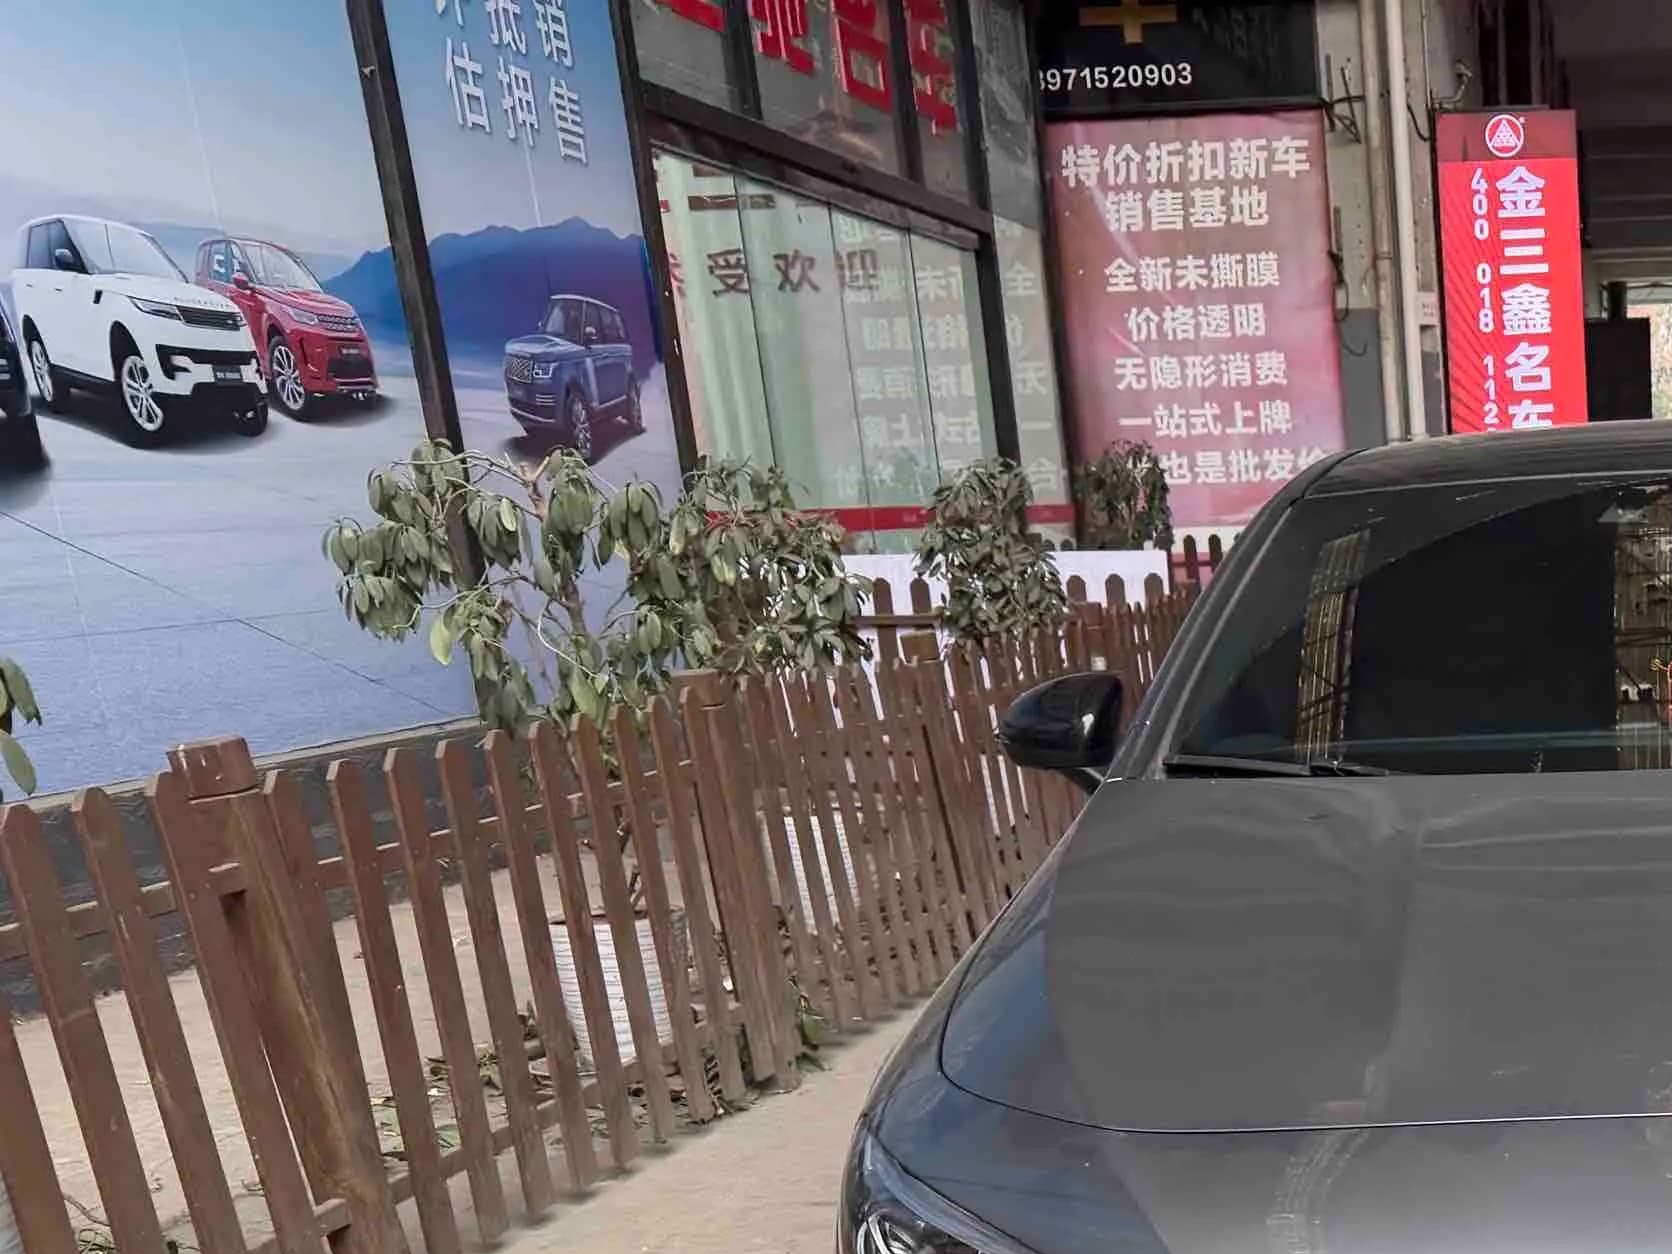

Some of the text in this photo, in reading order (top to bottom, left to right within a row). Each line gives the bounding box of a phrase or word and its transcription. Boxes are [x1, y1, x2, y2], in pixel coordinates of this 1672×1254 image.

[1061, 135, 1311, 187] 特价折扣新车
[1103, 185, 1270, 232] 销售基地
[1104, 251, 1281, 293] 全新未撕膜
[1126, 303, 1267, 342] 价格透明
[1114, 350, 1288, 391] 无隐形消费
[1483, 354, 1500, 431] 112
[1119, 399, 1293, 438] 一站式上牌
